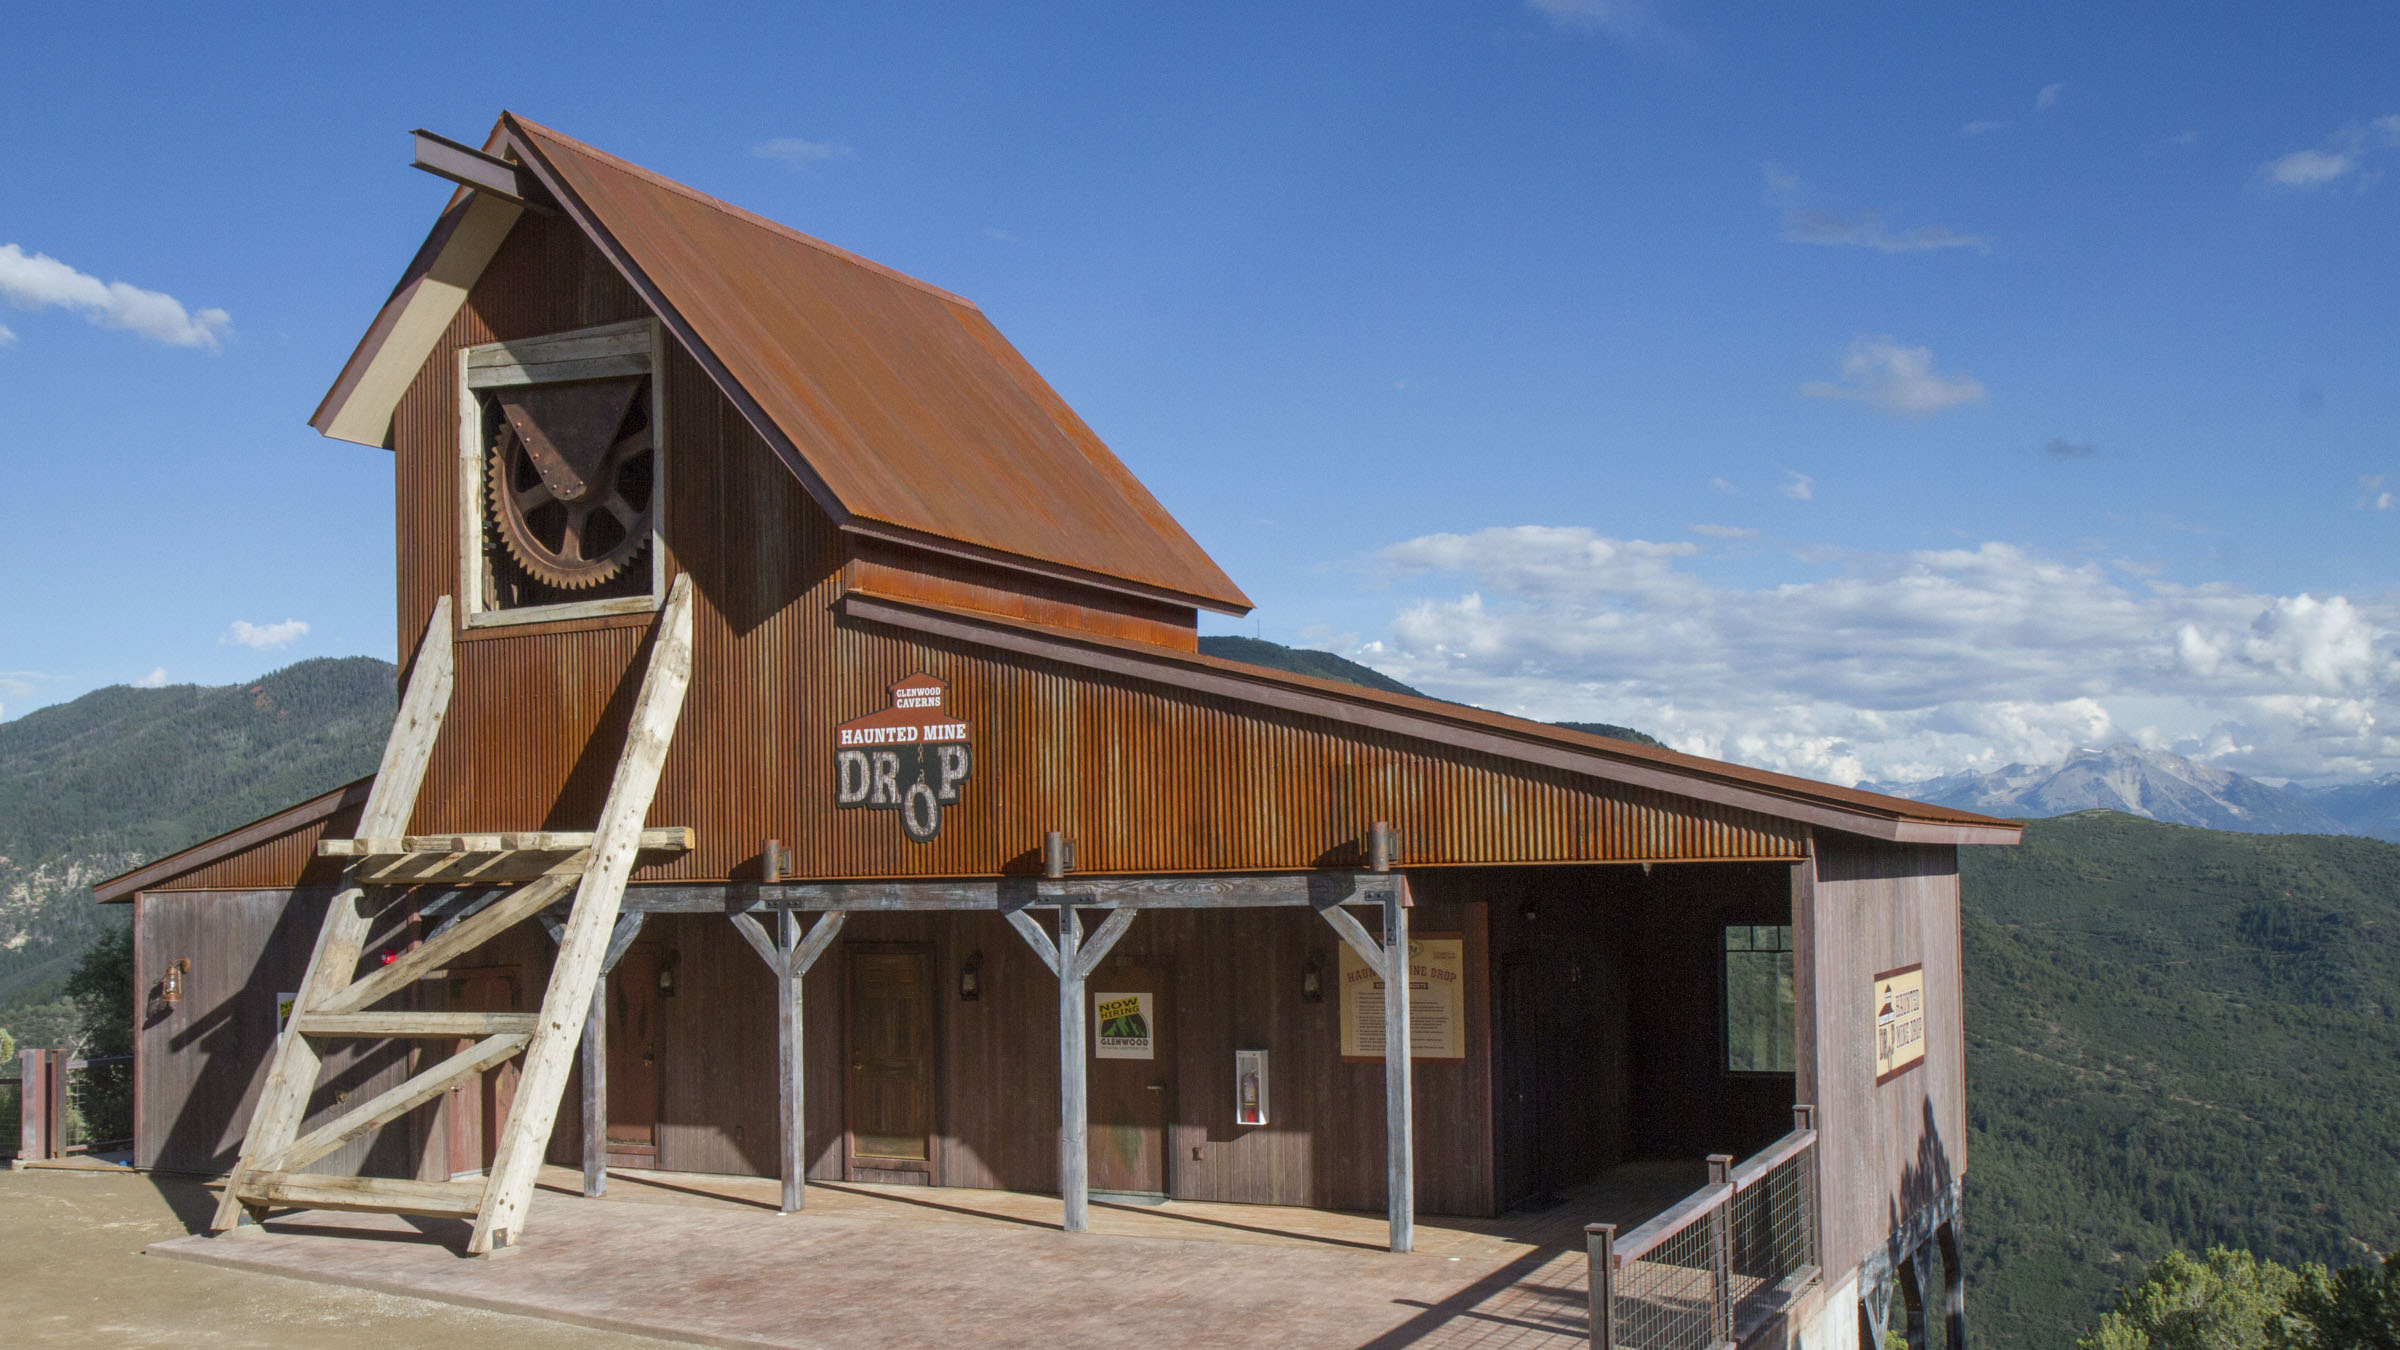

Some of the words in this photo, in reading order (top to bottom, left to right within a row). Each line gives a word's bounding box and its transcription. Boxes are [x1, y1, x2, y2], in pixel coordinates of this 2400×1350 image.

[897, 687, 940, 698] GLENWOOD
[897, 697, 940, 708] CAVERNS
[841, 726, 918, 744] HAUNTED
[923, 723, 966, 740] MINE
[838, 745, 969, 837] DROP
[1347, 967, 1377, 983] HAUN
[1409, 965, 1427, 977] INE
[1431, 967, 1457, 983] DROP
[1099, 998, 1138, 1011] NOW
[1895, 988, 1919, 1018] HAUNTED
[1101, 1006, 1139, 1019] HIRING
[1101, 1038, 1148, 1046] GLENWOOD
